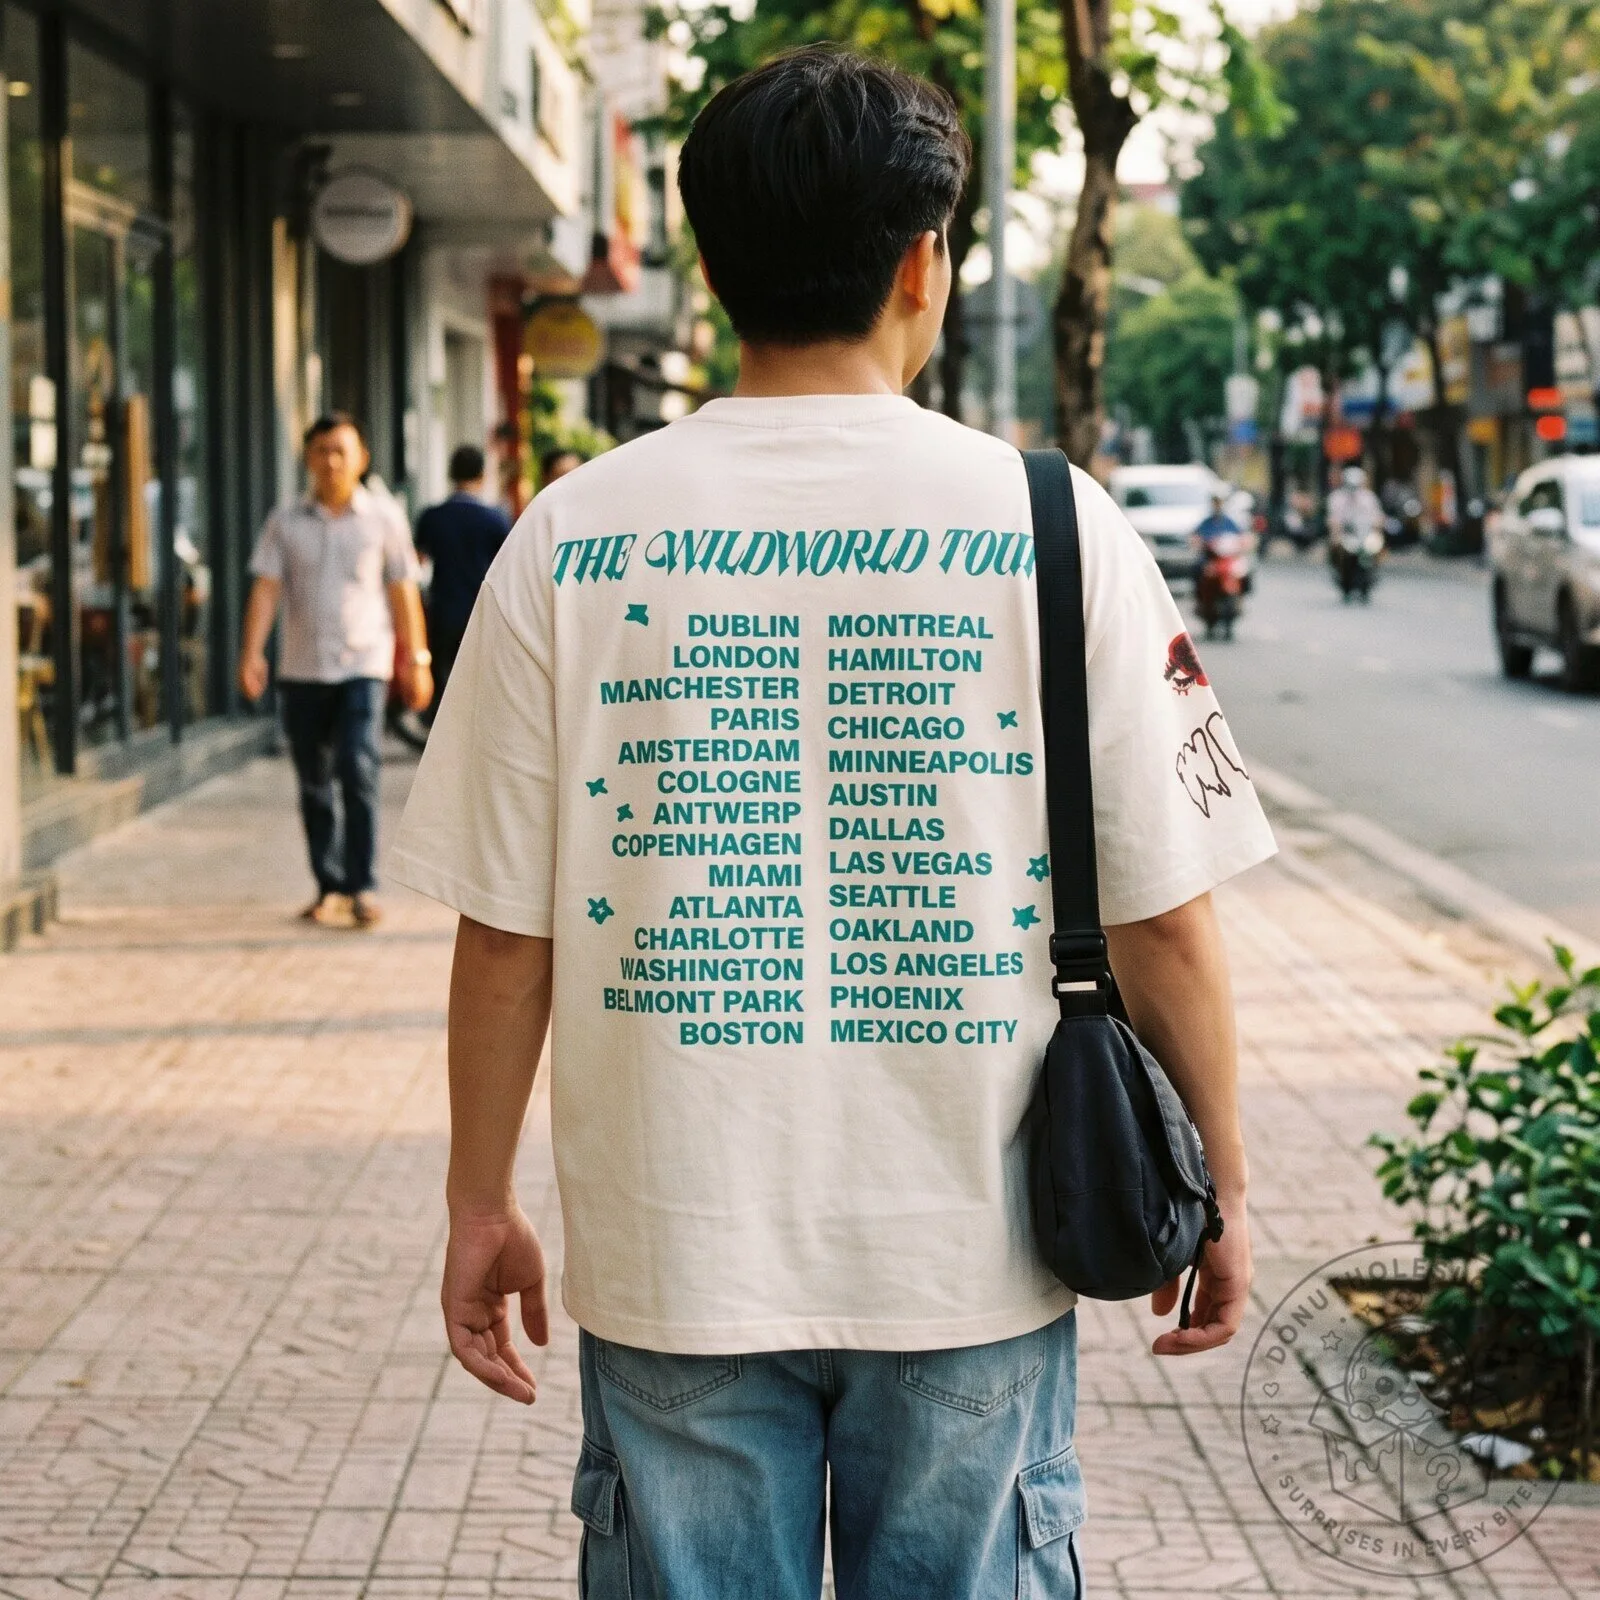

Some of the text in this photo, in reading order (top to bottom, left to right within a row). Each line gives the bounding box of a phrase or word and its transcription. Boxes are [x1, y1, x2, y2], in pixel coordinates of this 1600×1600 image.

[552, 528, 1036, 587] THE WILDWORLD TOU
[688, 614, 800, 638] DUBLIN
[828, 614, 993, 639] MONTREAL
[673, 645, 799, 669] LONDON
[828, 648, 982, 672] HAMILTON
[600, 676, 799, 705] MANCHESTER
[828, 681, 955, 705] DETROIT
[711, 707, 800, 731] PARIS
[827, 716, 965, 740] CHICAGO
[618, 738, 800, 764] AMSTERDAM
[829, 750, 1034, 776] MINNEAPOLIS
[657, 770, 800, 794] COLOGNE
[828, 783, 937, 807] AUSTIN
[653, 801, 801, 825] ANTWERP
[829, 817, 945, 841] DALLAS
[612, 832, 801, 857] COPENHAGEN
[829, 851, 992, 875] LAS VEGAS
[709, 864, 802, 887] MIAMI
[669, 895, 803, 919] ATLANTA
[829, 884, 956, 909] SEATTLE
[635, 927, 804, 951] CHARLOTTE
[829, 918, 974, 943] OAKLAND
[621, 958, 803, 982] WASHINGTON
[830, 952, 1023, 977] LOS ANGELES
[604, 988, 804, 1014] BELMONT PARK
[830, 985, 963, 1010] PHOENIX
[680, 1021, 804, 1046] BOSTON
[830, 1019, 1018, 1045] MEXICO CITY
